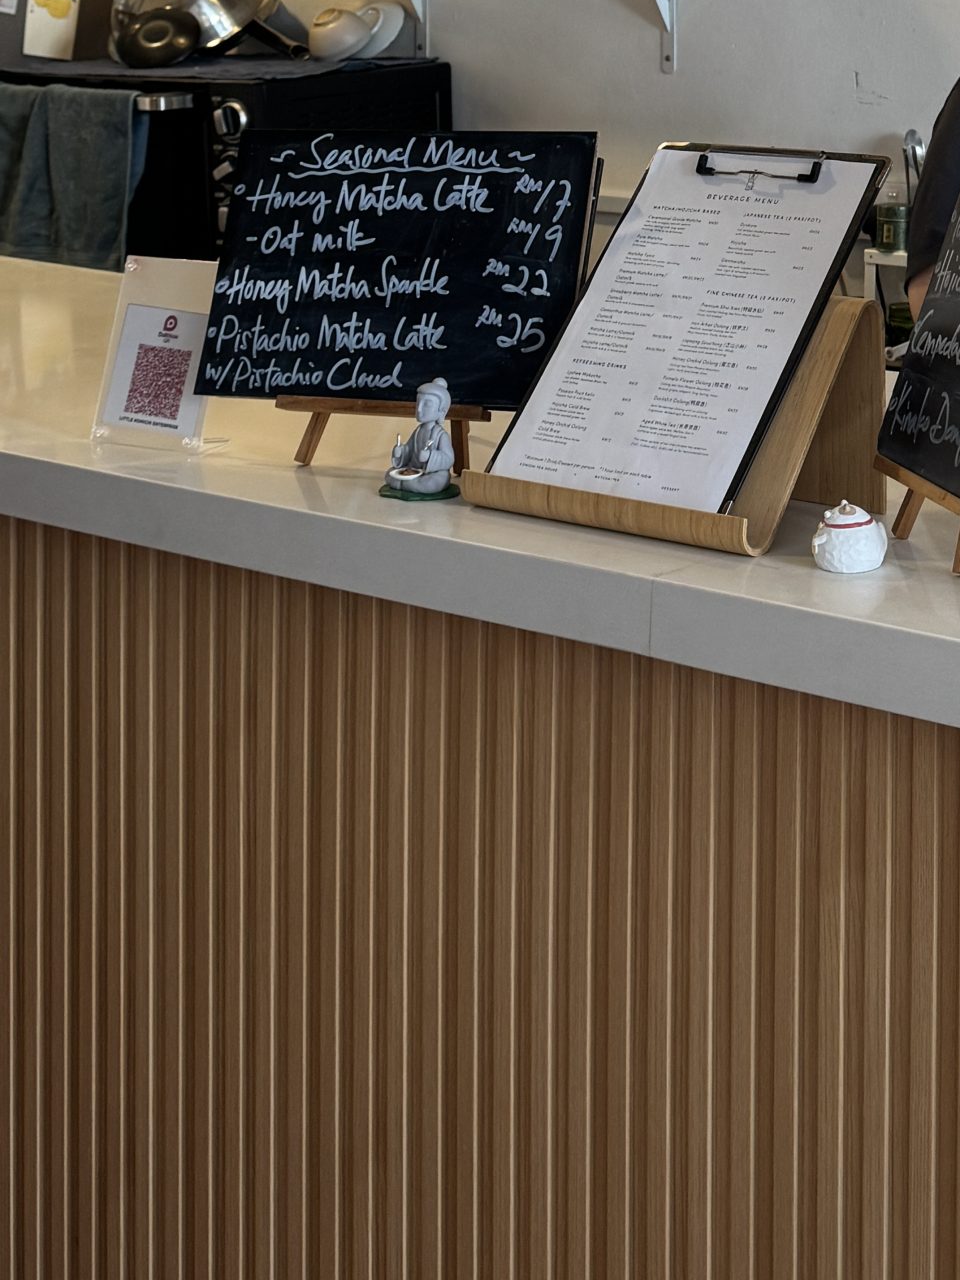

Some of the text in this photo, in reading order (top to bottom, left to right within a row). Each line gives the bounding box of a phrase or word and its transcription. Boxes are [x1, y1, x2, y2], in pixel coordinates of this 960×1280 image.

[300, 133, 500, 169] Seasonal Menu
[246, 174, 332, 224] Honey
[336, 173, 428, 216] Matcha
[434, 175, 494, 213] Latte
[706, 194, 751, 202] BEVERAGE
[226, 265, 293, 314] Honey
[295, 262, 370, 302] Matcha
[375, 255, 449, 307] Sparkle
[216, 315, 309, 358] Pistachio
[317, 312, 387, 353] Matcha
[393, 312, 448, 351] Latte
[327, 357, 403, 391] Cloud
